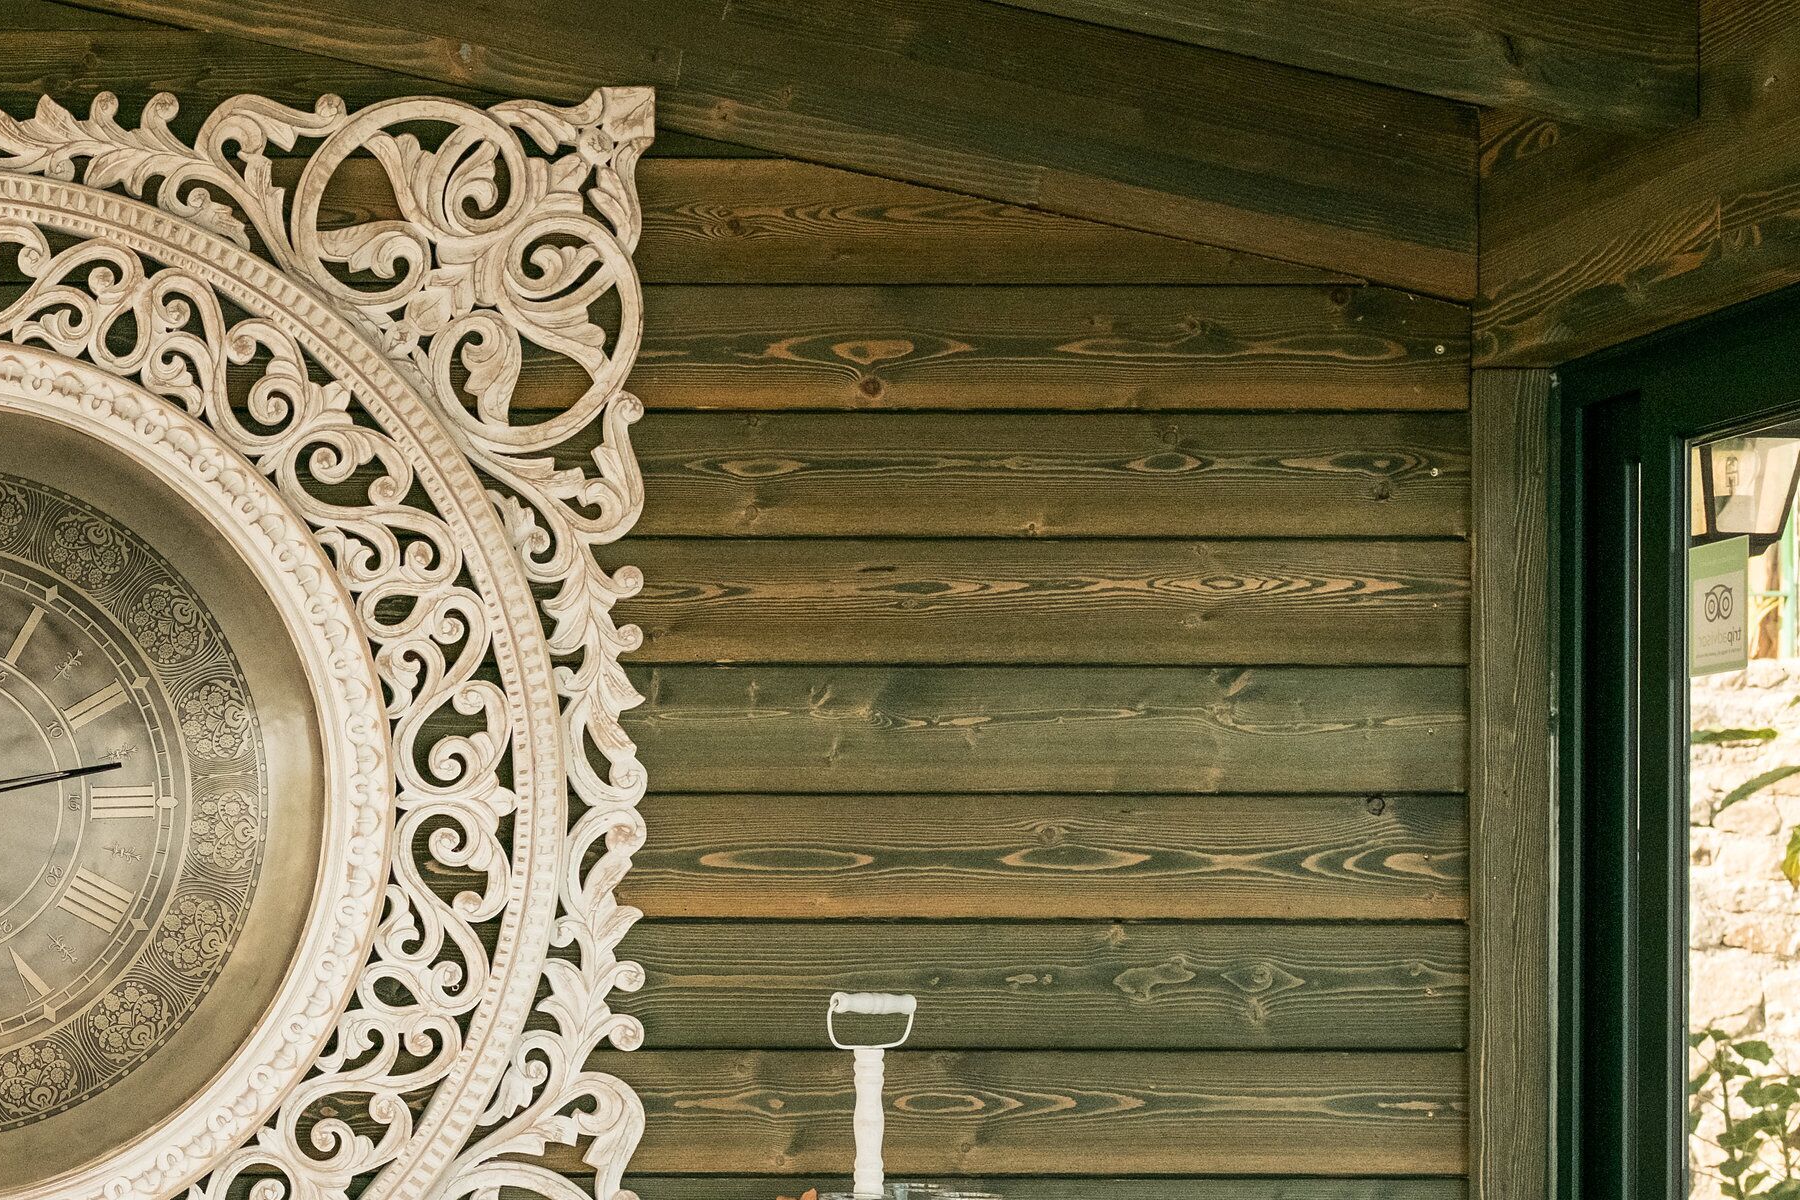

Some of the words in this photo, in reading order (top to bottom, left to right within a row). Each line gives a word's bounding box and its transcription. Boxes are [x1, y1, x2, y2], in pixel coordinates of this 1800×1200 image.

[60, 677, 132, 734] II
[46, 720, 65, 739] 10
[68, 793, 81, 812] 15
[90, 782, 156, 822] III
[45, 864, 65, 888] 20
[55, 862, 137, 936] IIII
